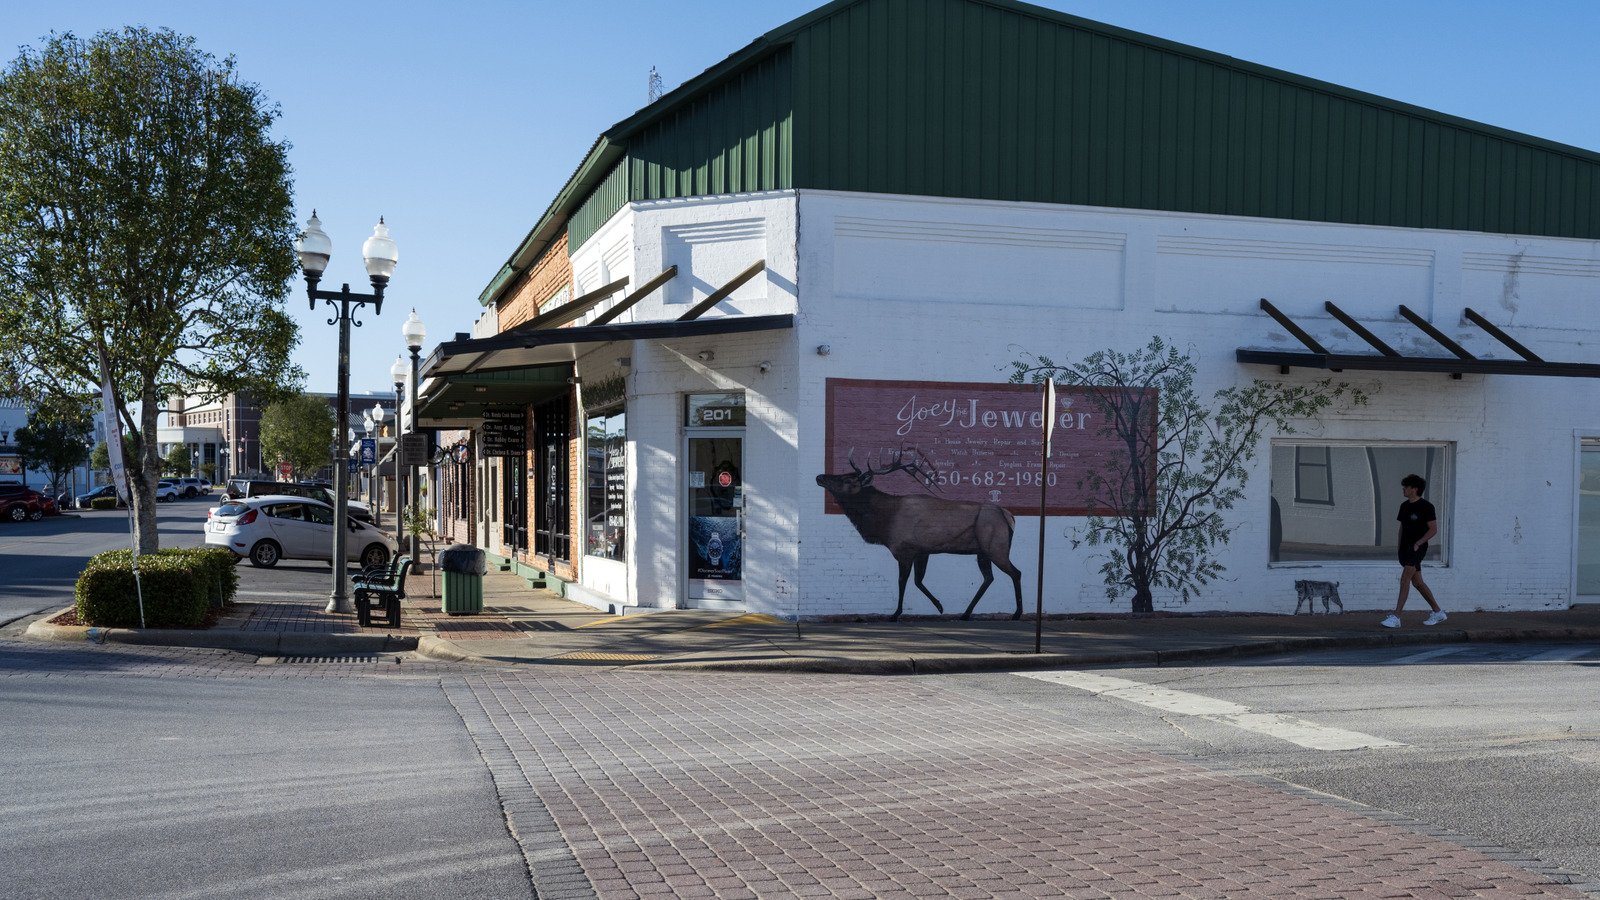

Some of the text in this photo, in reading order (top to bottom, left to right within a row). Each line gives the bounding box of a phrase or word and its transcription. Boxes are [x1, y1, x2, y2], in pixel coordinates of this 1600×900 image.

[703, 409, 732, 421] 201
[896, 394, 956, 436] Joey
[959, 398, 1092, 431] Jeweer
[993, 438, 1011, 447] Repair
[888, 447, 914, 458] Engrving
[1027, 460, 1044, 468] Fram
